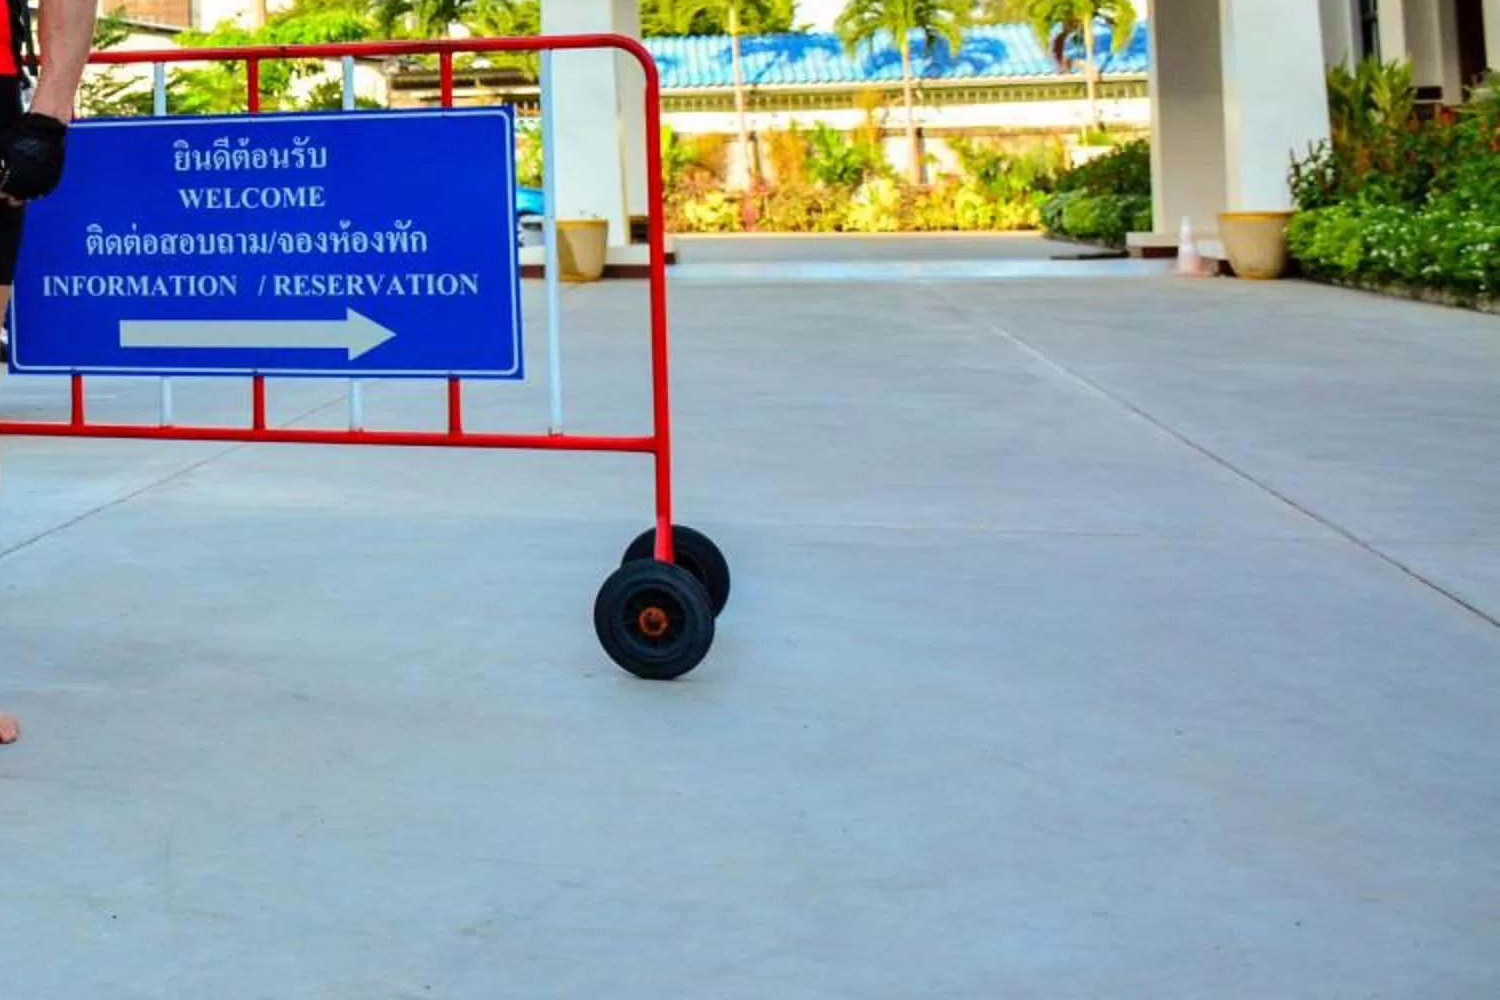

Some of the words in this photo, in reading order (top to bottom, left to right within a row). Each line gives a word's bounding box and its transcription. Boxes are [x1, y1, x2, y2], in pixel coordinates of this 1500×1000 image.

[172, 136, 328, 172] ยินดีต้อนรับ
[178, 185, 326, 210] WELCOME
[42, 274, 238, 298] INFORMATION
[273, 272, 480, 297] RESERVATION
